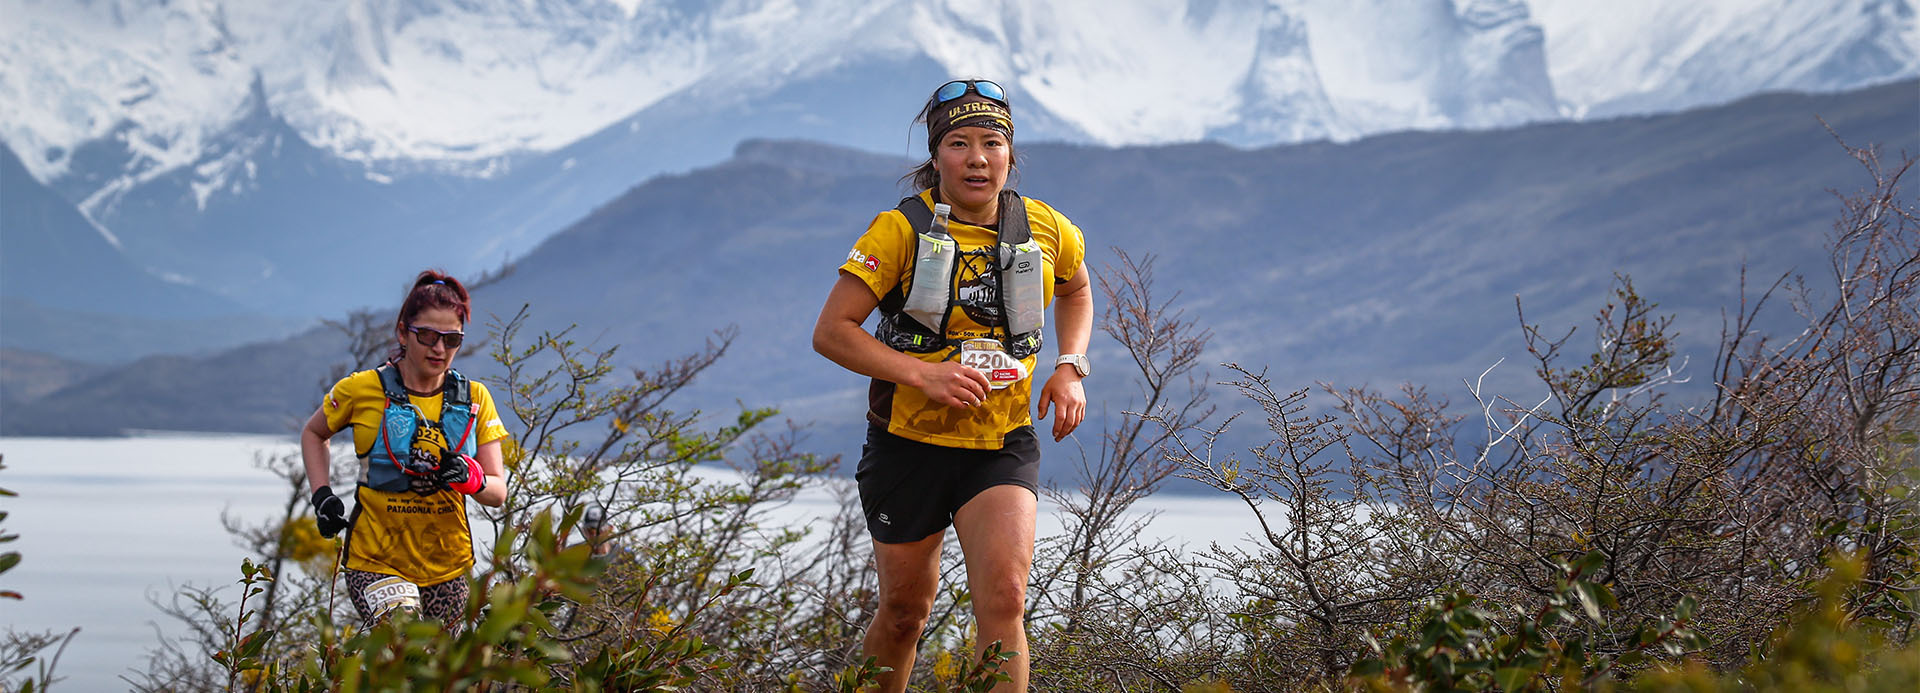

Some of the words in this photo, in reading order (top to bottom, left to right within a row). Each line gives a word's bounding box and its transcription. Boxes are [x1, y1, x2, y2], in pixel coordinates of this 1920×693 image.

[948, 102, 992, 118] ULTRA
[386, 505, 432, 515] PATAGONIA
[368, 584, 416, 606] 33005
